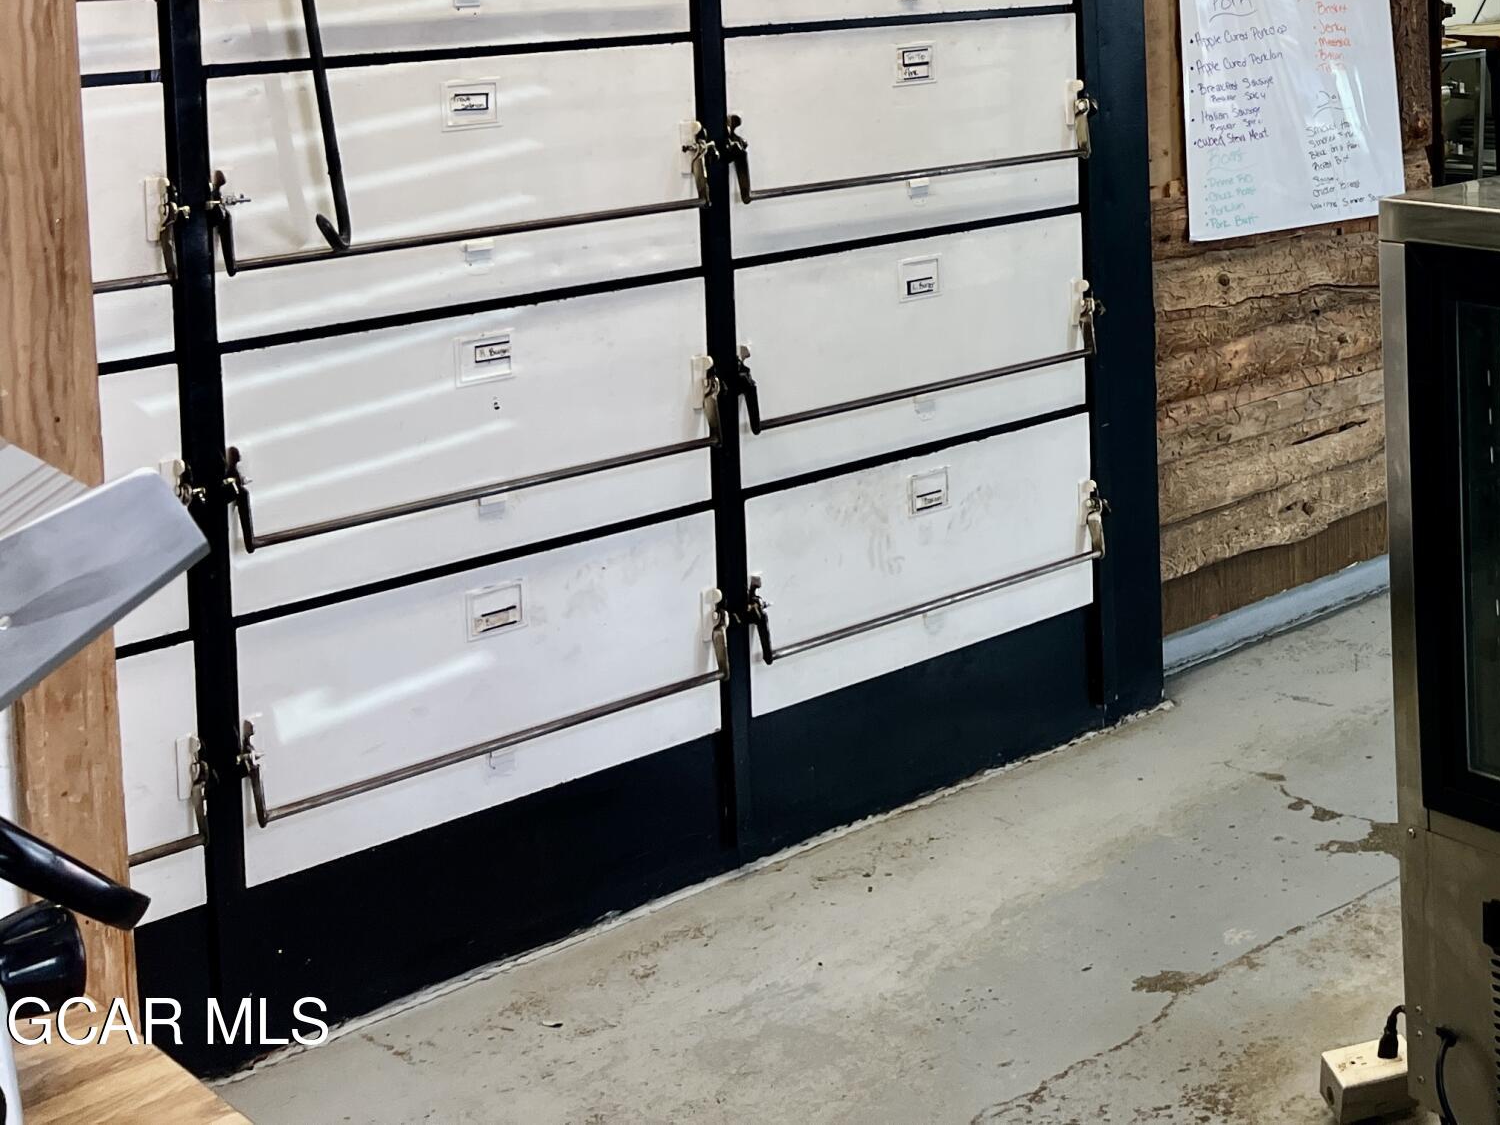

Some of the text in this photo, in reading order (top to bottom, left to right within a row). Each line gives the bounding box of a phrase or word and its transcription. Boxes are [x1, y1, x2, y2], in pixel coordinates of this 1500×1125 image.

[1319, 19, 1347, 34] Jerky
[1195, 32, 1221, 51] Apple
[1196, 59, 1221, 76] Apple
[1223, 57, 1247, 70] Cured
[1201, 110, 1229, 124] Italian
[1249, 127, 1269, 142] Meat
